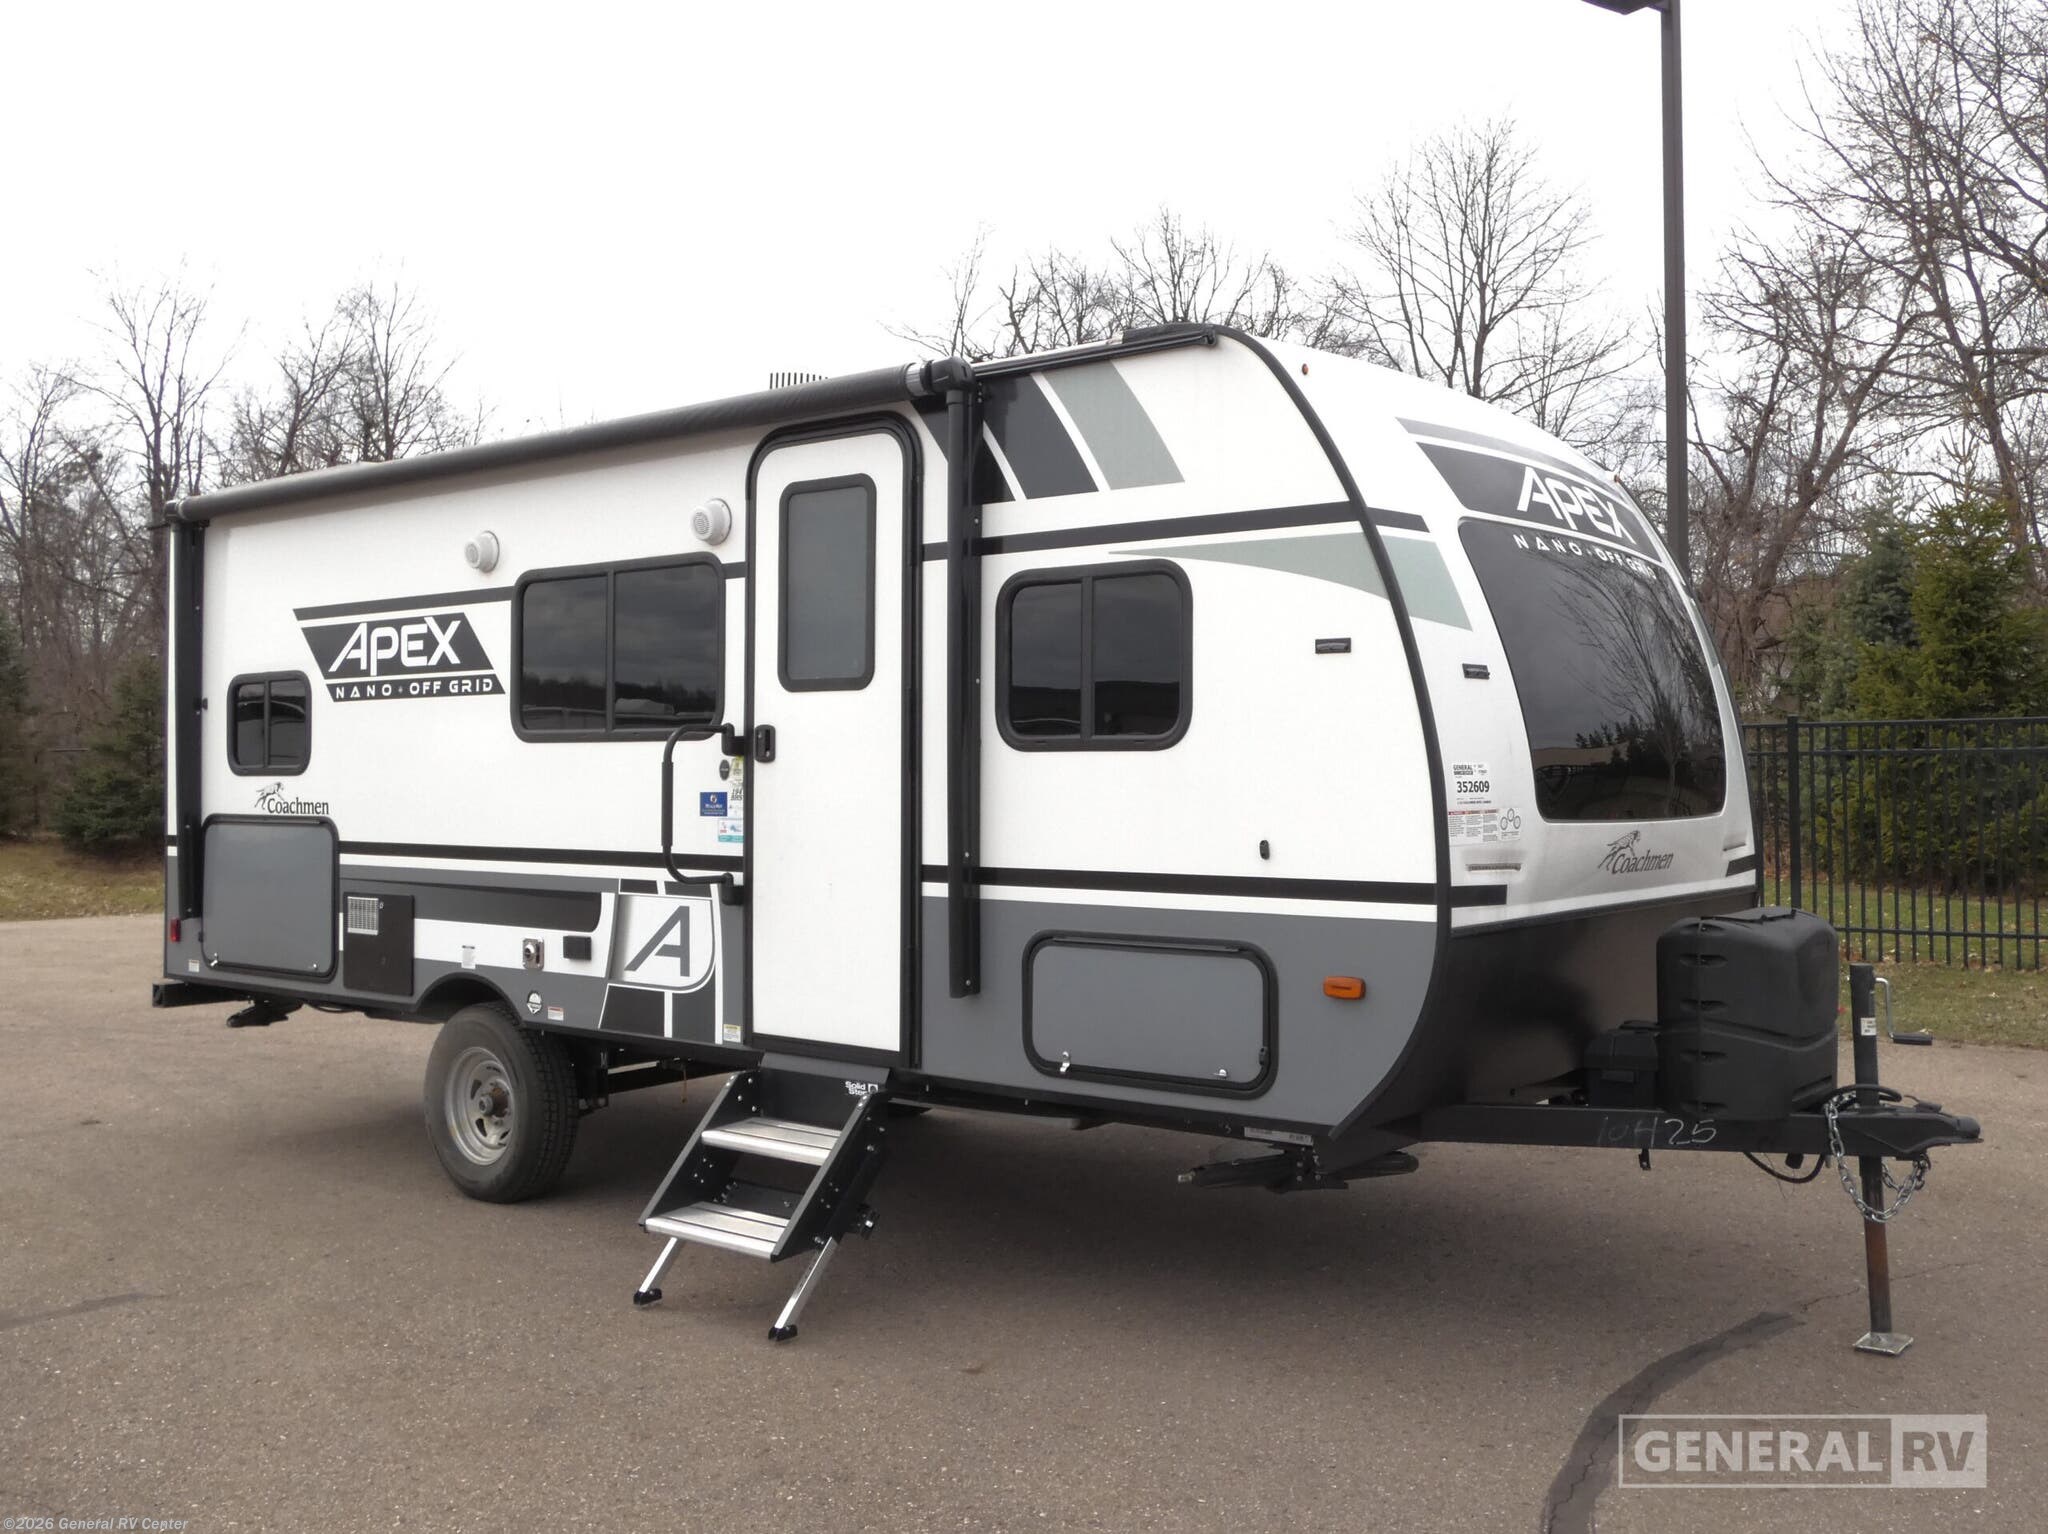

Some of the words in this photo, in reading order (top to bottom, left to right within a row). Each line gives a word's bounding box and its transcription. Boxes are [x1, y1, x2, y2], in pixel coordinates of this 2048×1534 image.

[1516, 466, 1637, 545] APEX
[1512, 533, 1583, 556] NANO
[1594, 547, 1624, 567] OFF
[328, 616, 461, 677] APEX
[335, 683, 392, 699] NANO
[409, 681, 441, 695] OFF
[449, 678, 493, 693] GRID
[1456, 780, 1490, 793] 352609
[267, 797, 329, 815] Coachmen
[1611, 849, 1674, 875] Coachmen
[624, 905, 690, 977] A
[845, 1081, 866, 1090] Solid
